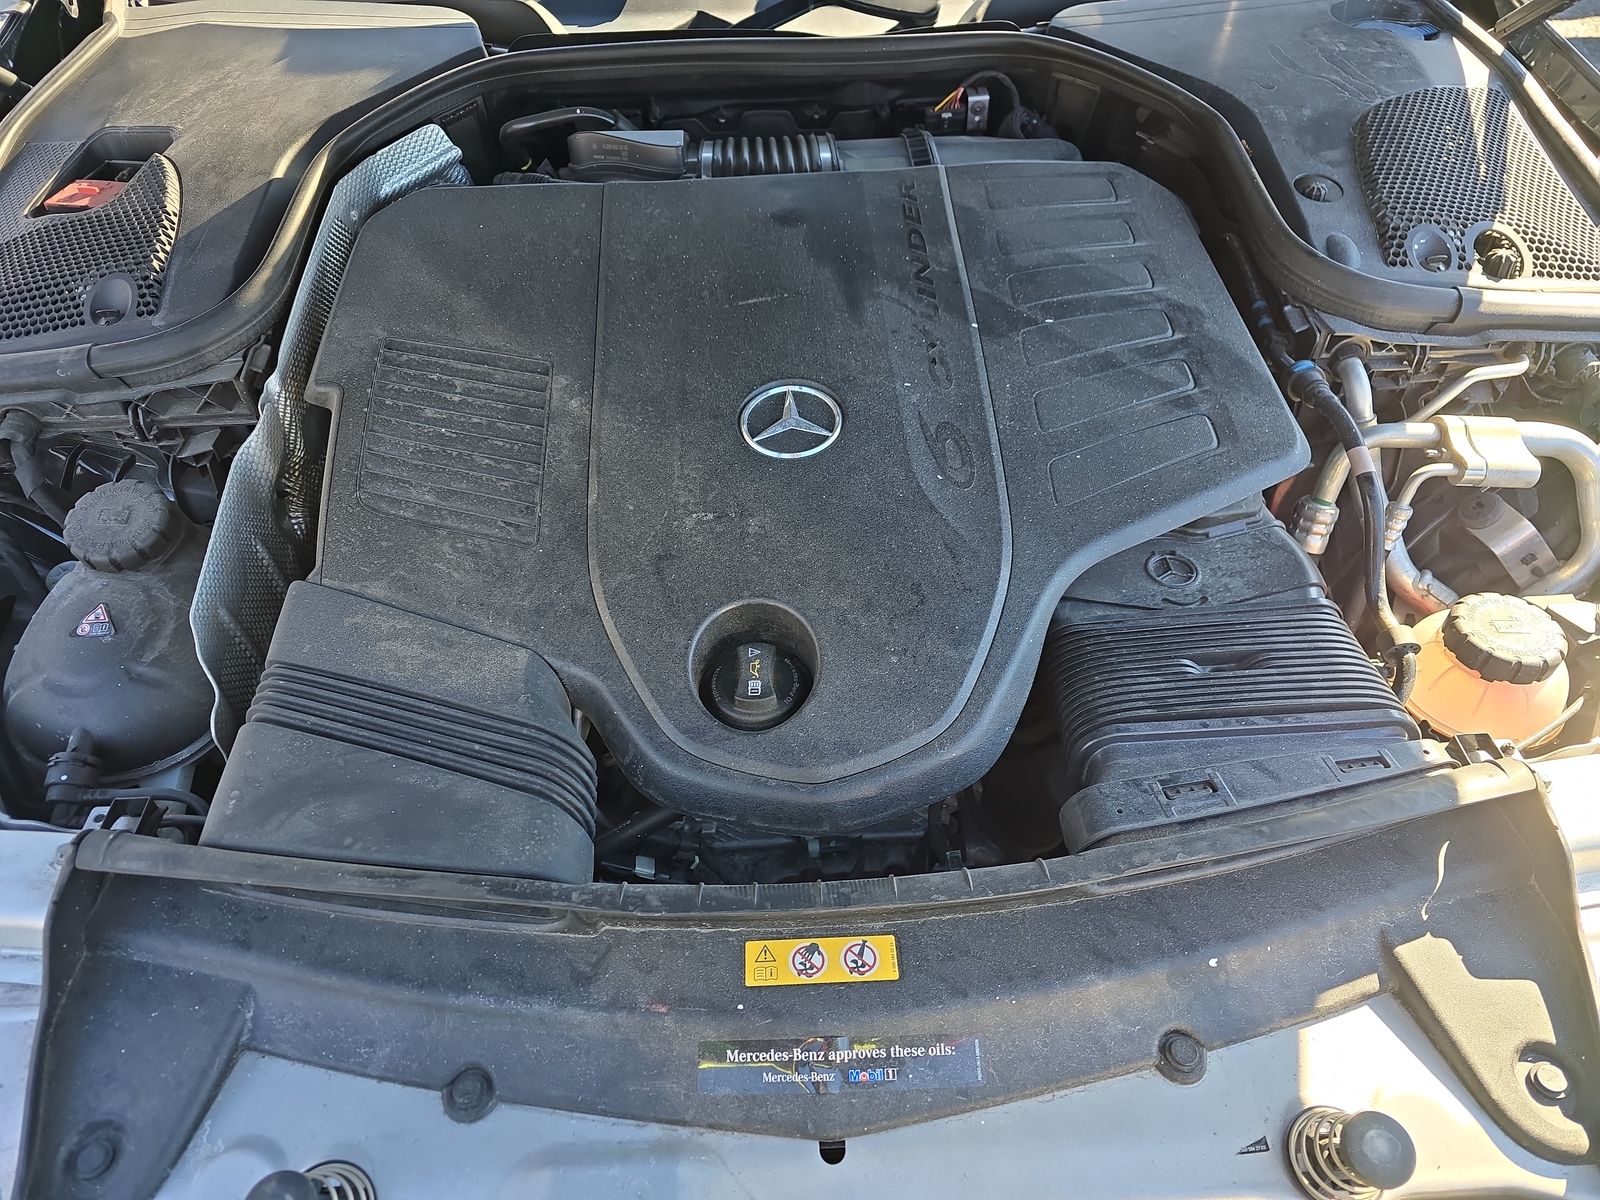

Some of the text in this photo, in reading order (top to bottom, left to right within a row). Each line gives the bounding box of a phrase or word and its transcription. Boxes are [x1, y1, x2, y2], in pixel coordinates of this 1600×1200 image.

[726, 1043, 956, 1063] Mercedes-Benz approves these oils:
[762, 1071, 836, 1083] Mercedes-Benz
[848, 1068, 884, 1083] Mobil
